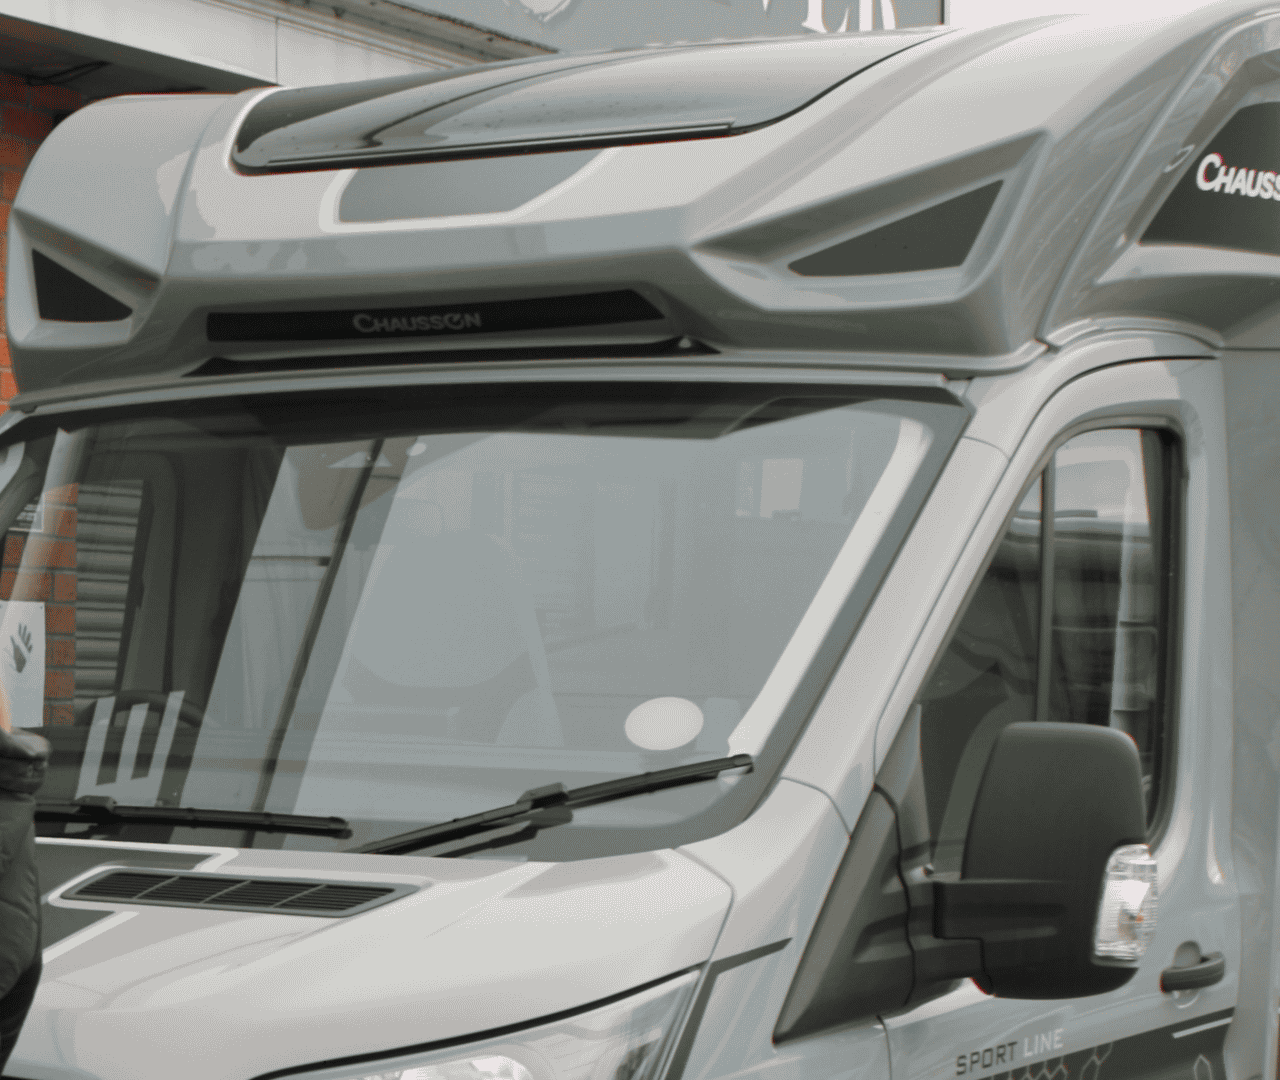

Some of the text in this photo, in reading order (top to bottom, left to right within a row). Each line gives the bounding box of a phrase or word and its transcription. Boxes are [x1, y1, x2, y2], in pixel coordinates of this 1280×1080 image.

[352, 312, 482, 333] CHAUSSON
[956, 1028, 1065, 1077] SPORT LINE
